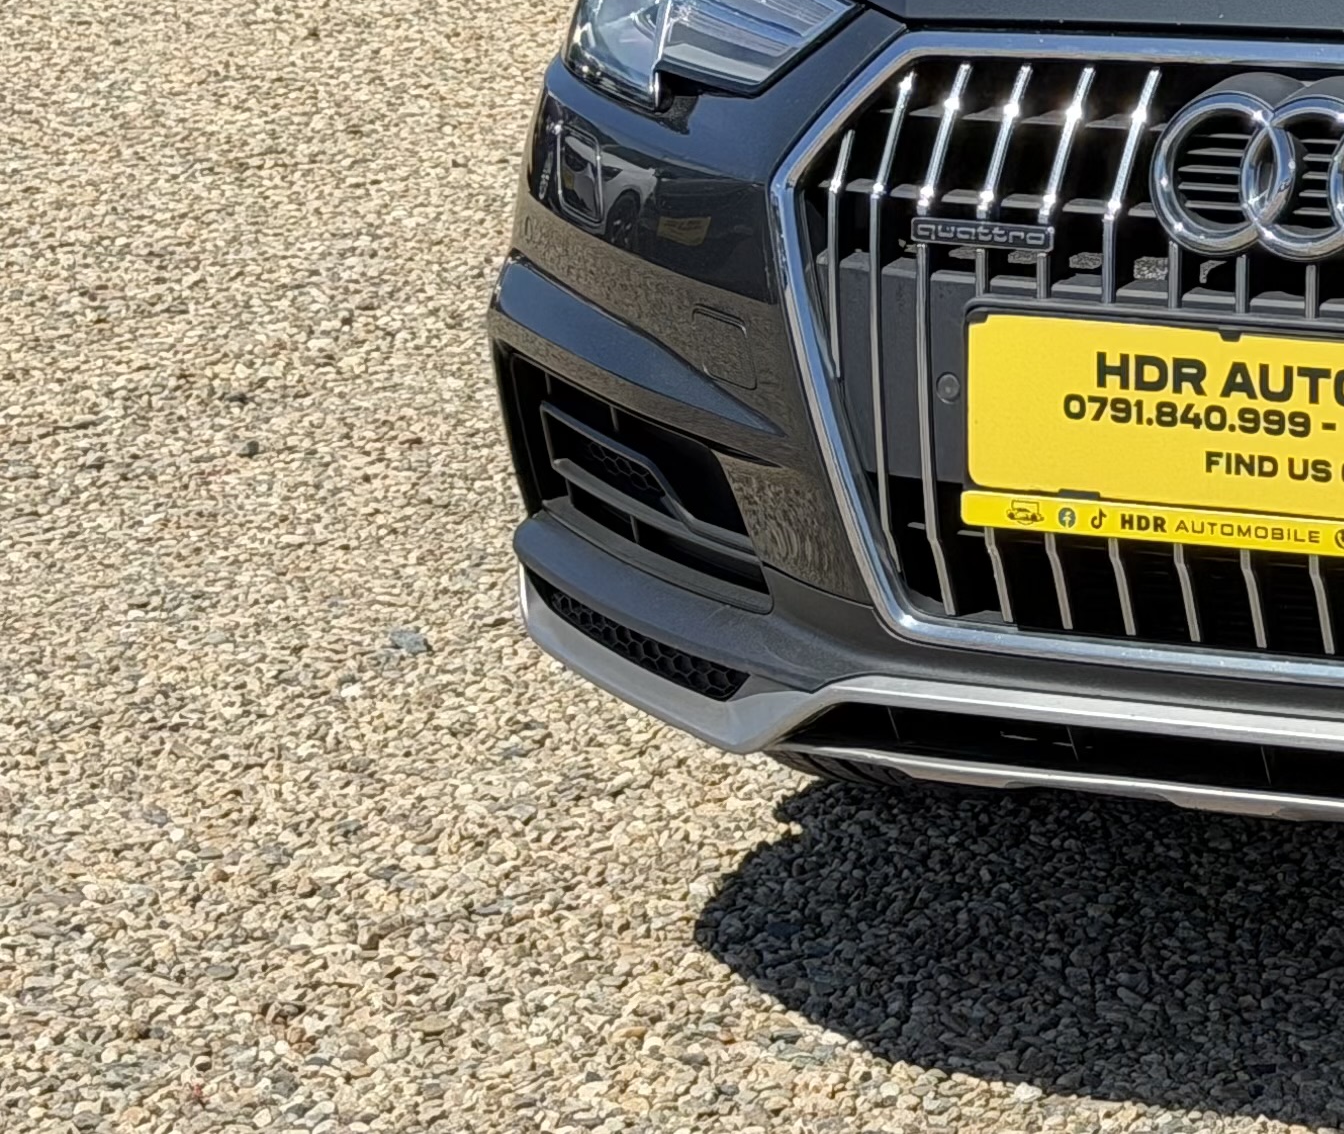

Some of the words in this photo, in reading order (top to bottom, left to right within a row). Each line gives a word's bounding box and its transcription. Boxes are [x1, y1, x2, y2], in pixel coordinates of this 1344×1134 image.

[916, 223, 1046, 246] quattro
[1096, 351, 1207, 396] HDR
[1063, 393, 1311, 438] 0791.840.999
[1205, 450, 1278, 478] FIND
[1287, 457, 1332, 483] US
[1120, 513, 1167, 534] HDR
[1174, 519, 1321, 544] AUTOMOBILE
